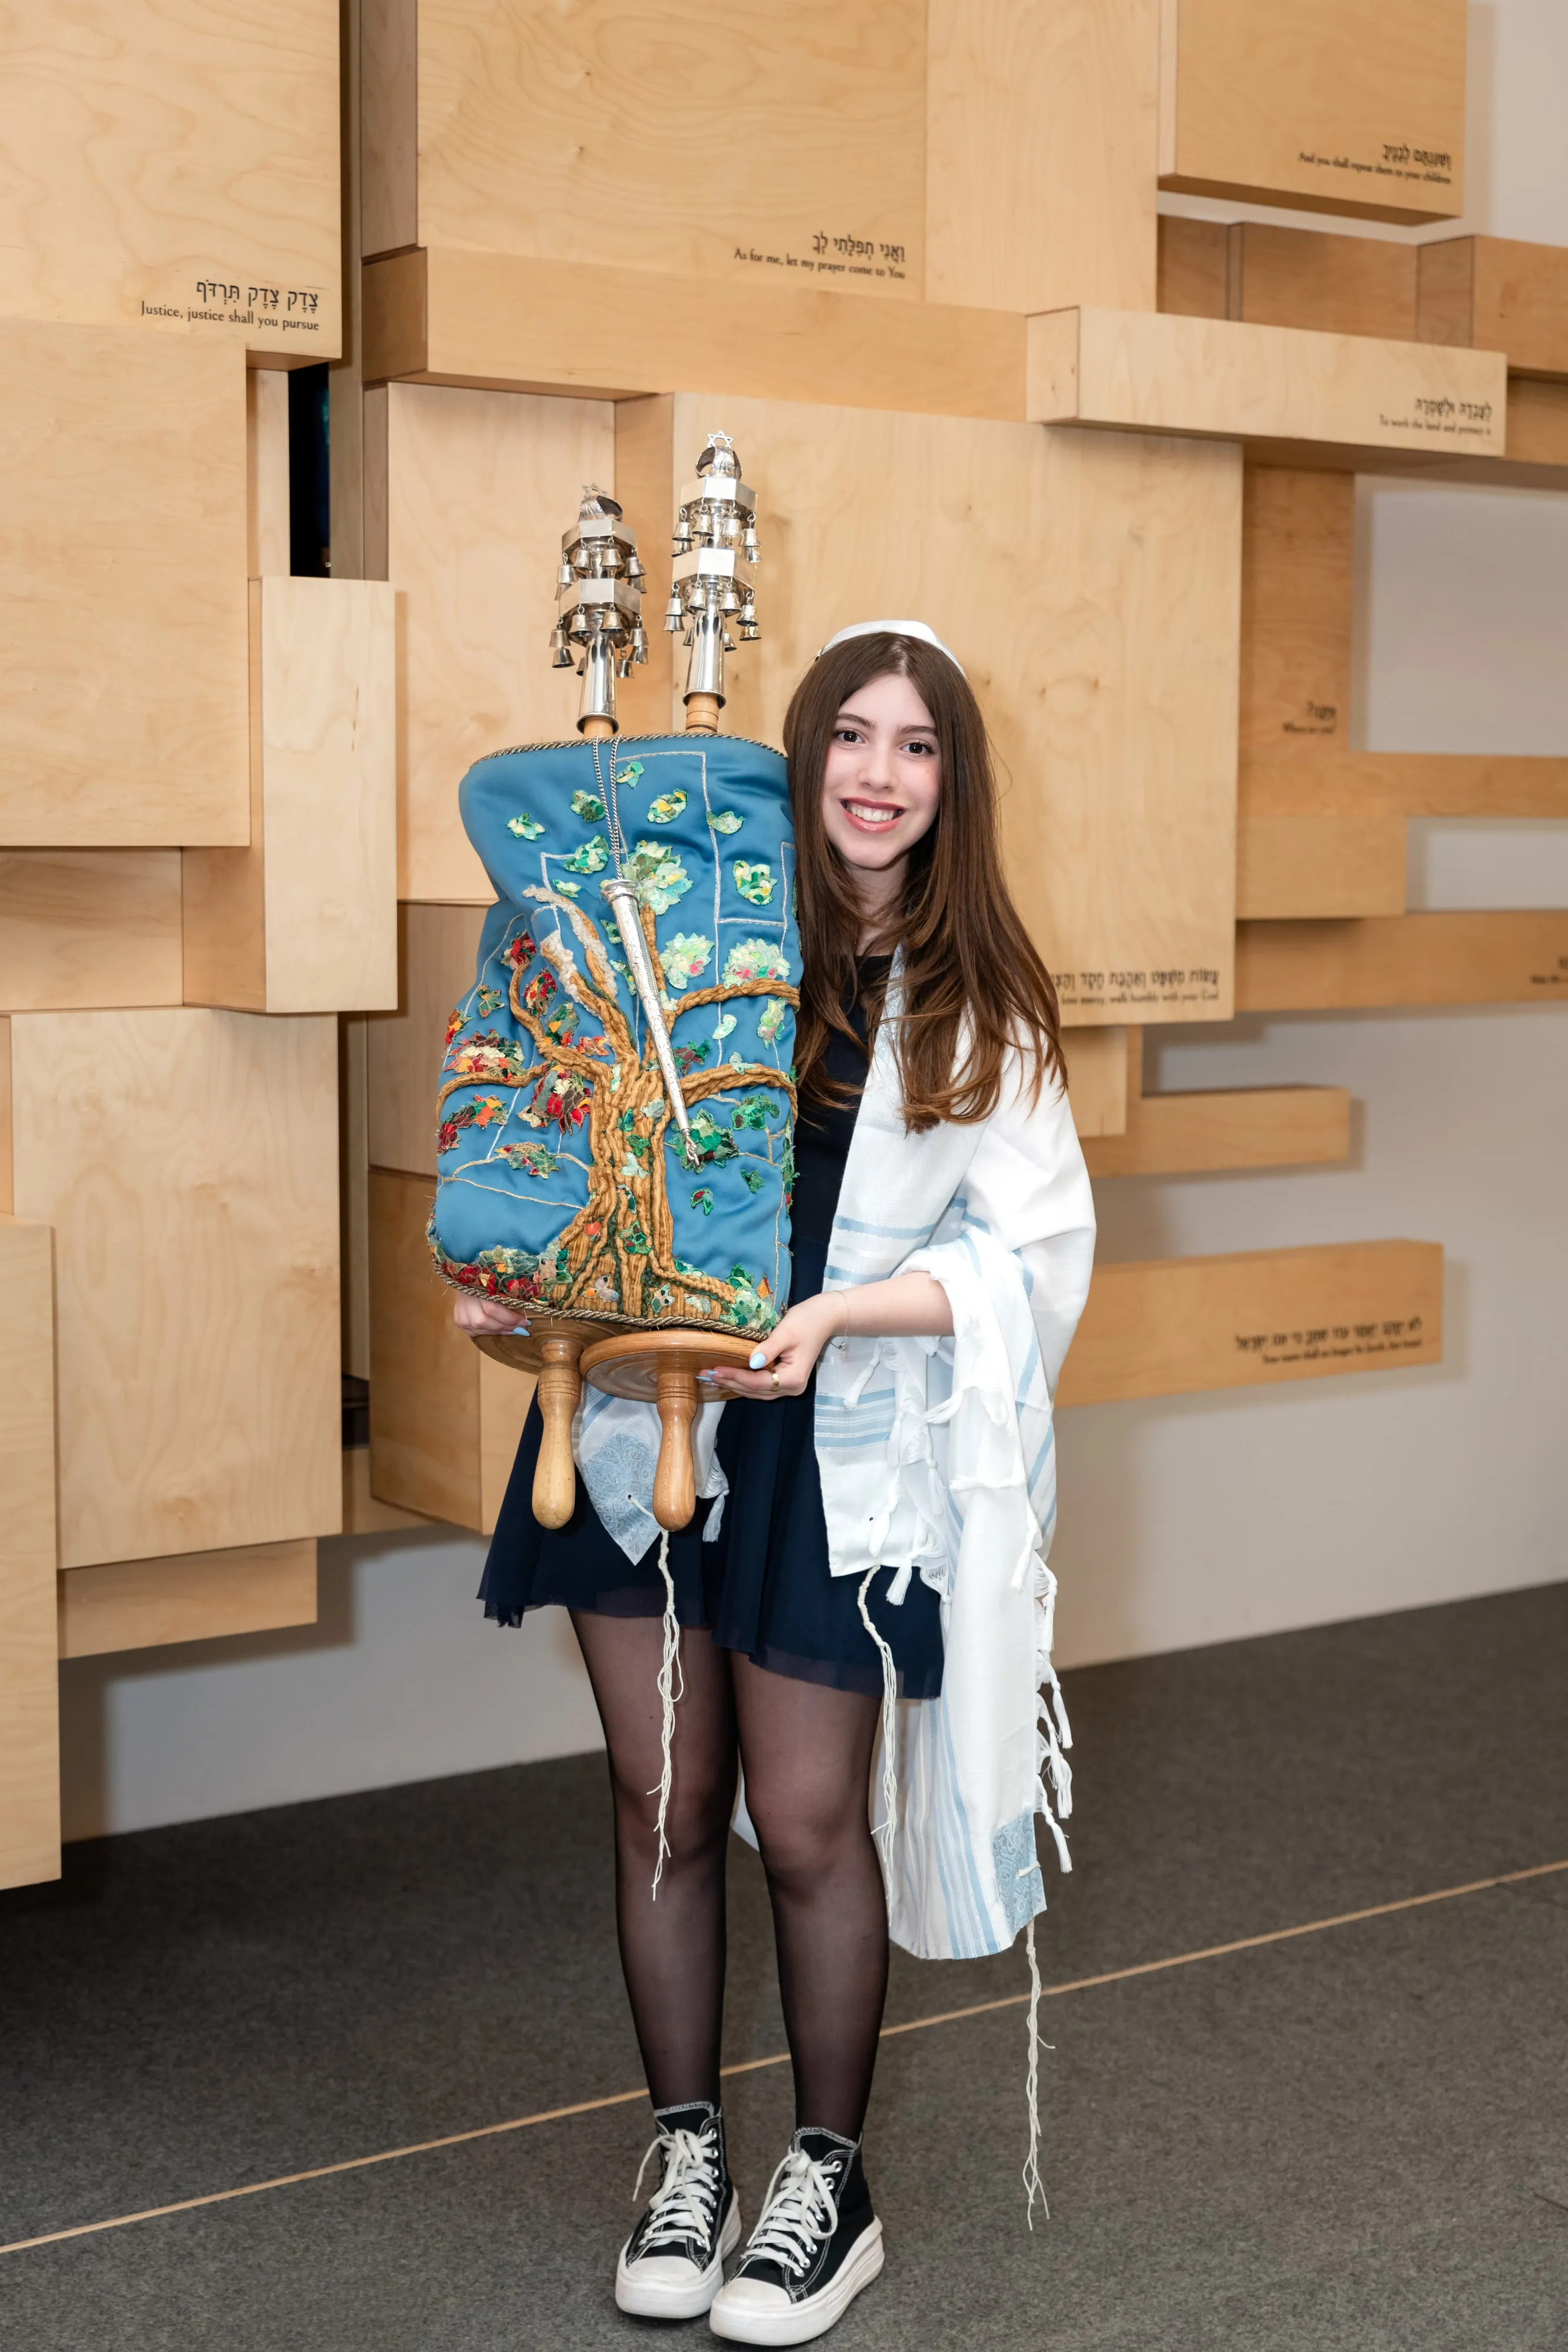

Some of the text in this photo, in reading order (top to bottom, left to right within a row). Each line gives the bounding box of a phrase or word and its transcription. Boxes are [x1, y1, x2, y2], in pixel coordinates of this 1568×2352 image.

[734, 248, 905, 279] As for me, let my prayer come to You
[141, 300, 320, 331] Justice, justice shall you pursue
